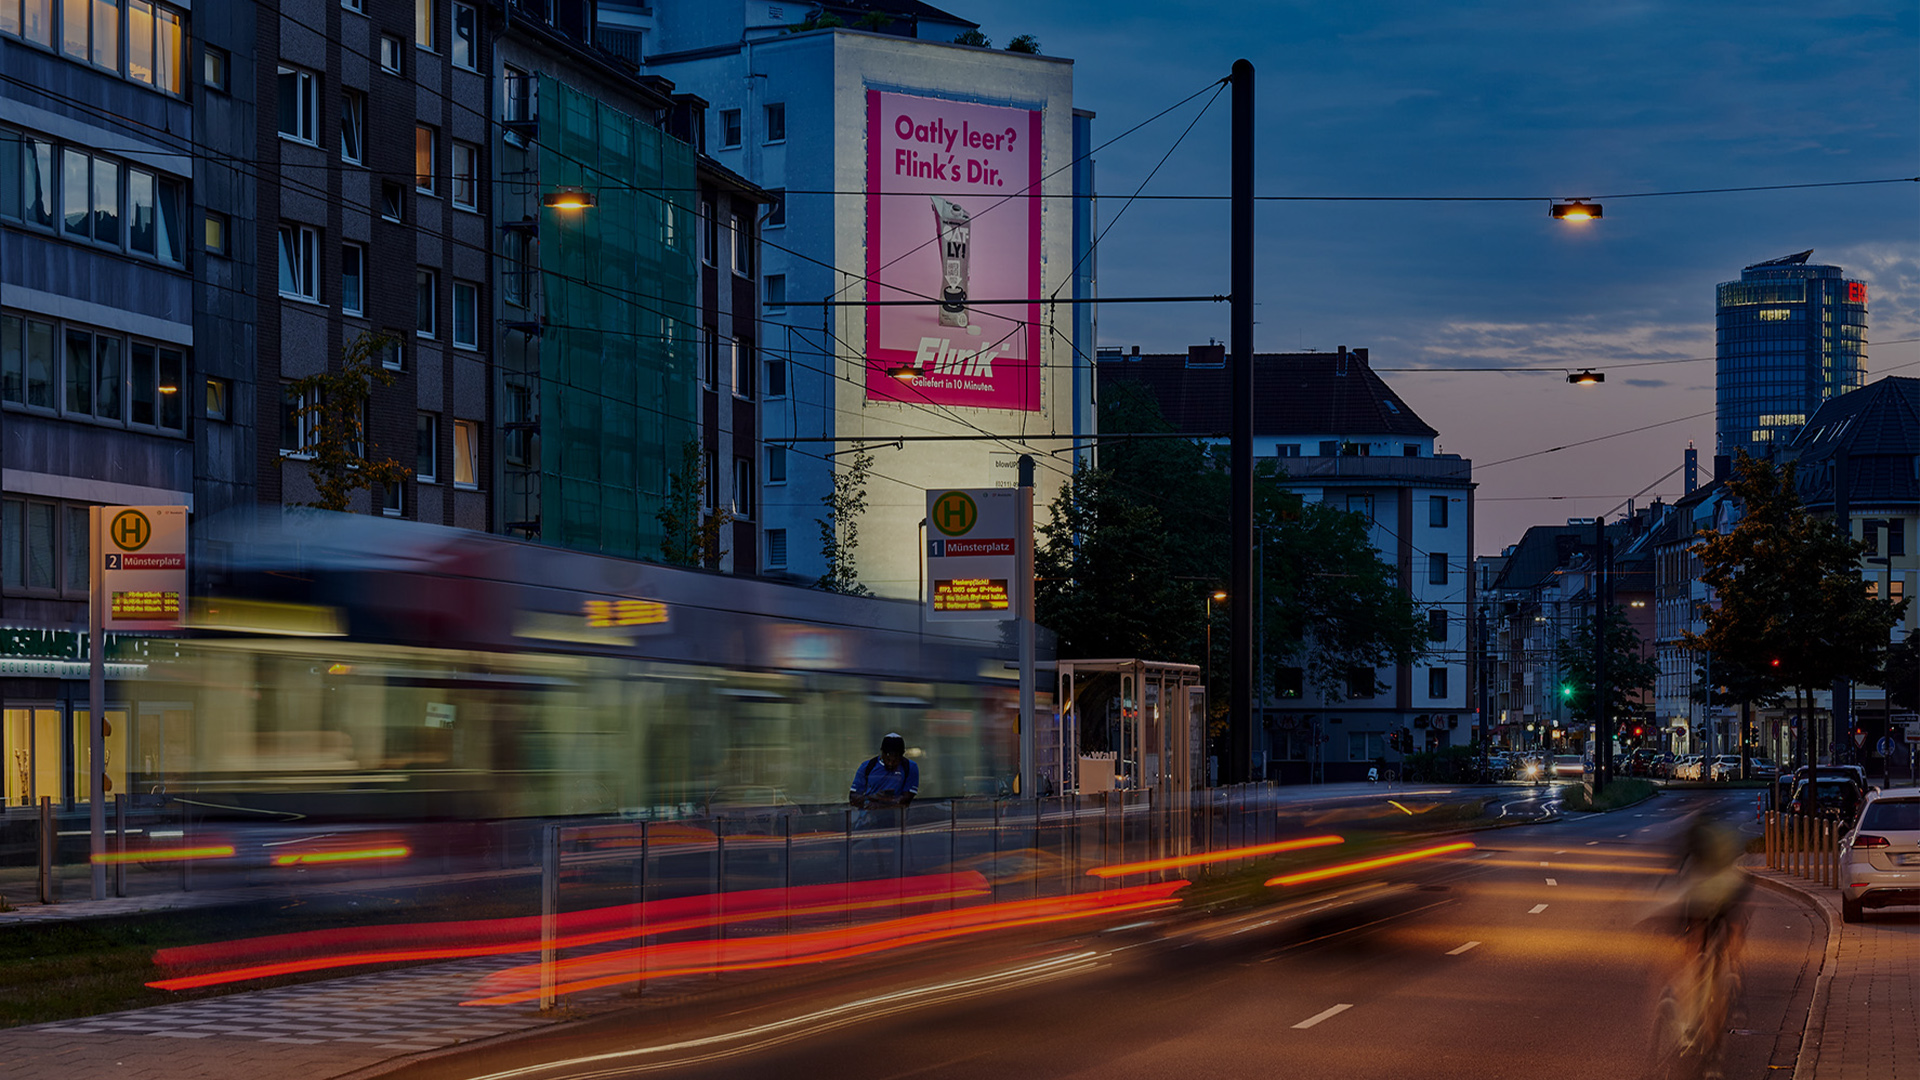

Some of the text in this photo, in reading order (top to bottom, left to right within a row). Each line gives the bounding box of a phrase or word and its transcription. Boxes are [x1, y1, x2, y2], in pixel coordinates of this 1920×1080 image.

[895, 115, 1017, 153] Oatly leer?
[967, 159, 1004, 187] Dir.
[947, 242, 966, 259] LY!
[913, 337, 999, 378] Flink
[911, 377, 995, 392] Geliefert in 10 Minuten.
[944, 500, 966, 527] H
[121, 518, 141, 543] H
[931, 541, 1010, 557] 1 Münsterplatz
[109, 556, 181, 568] 2 Münsterplatz
[61, 665, 82, 675] UND
[1090, 751, 1118, 760] Wall
